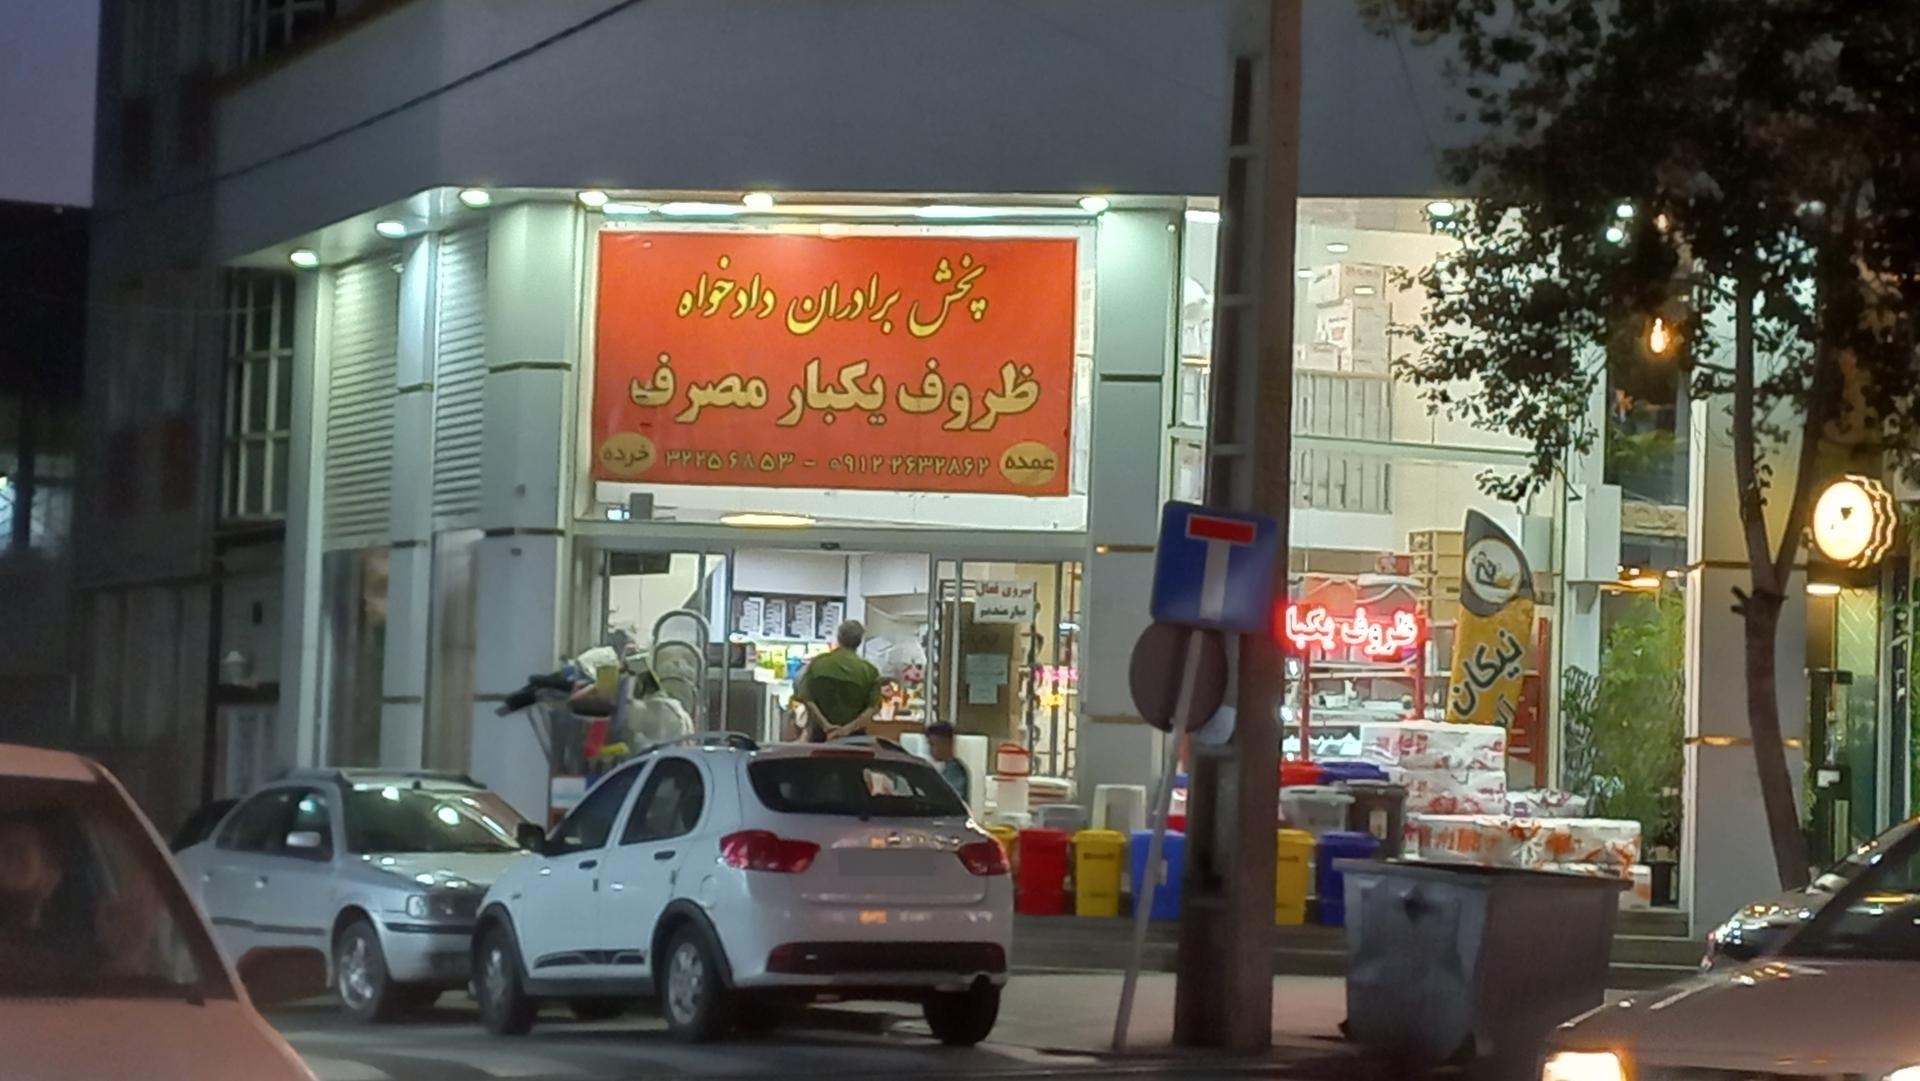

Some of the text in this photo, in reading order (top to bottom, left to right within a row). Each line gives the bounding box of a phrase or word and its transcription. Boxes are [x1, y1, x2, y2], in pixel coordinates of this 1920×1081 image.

[678, 253, 987, 338] پخش برادران دادخواه
[629, 352, 1041, 431] ظروف یکبار مصرف
[603, 444, 650, 468] خرده
[666, 449, 796, 472] ۳۲۲۵۶۸۵۳
[1004, 455, 1055, 471] عمده
[1286, 604, 1418, 656] ظروف یکبا
